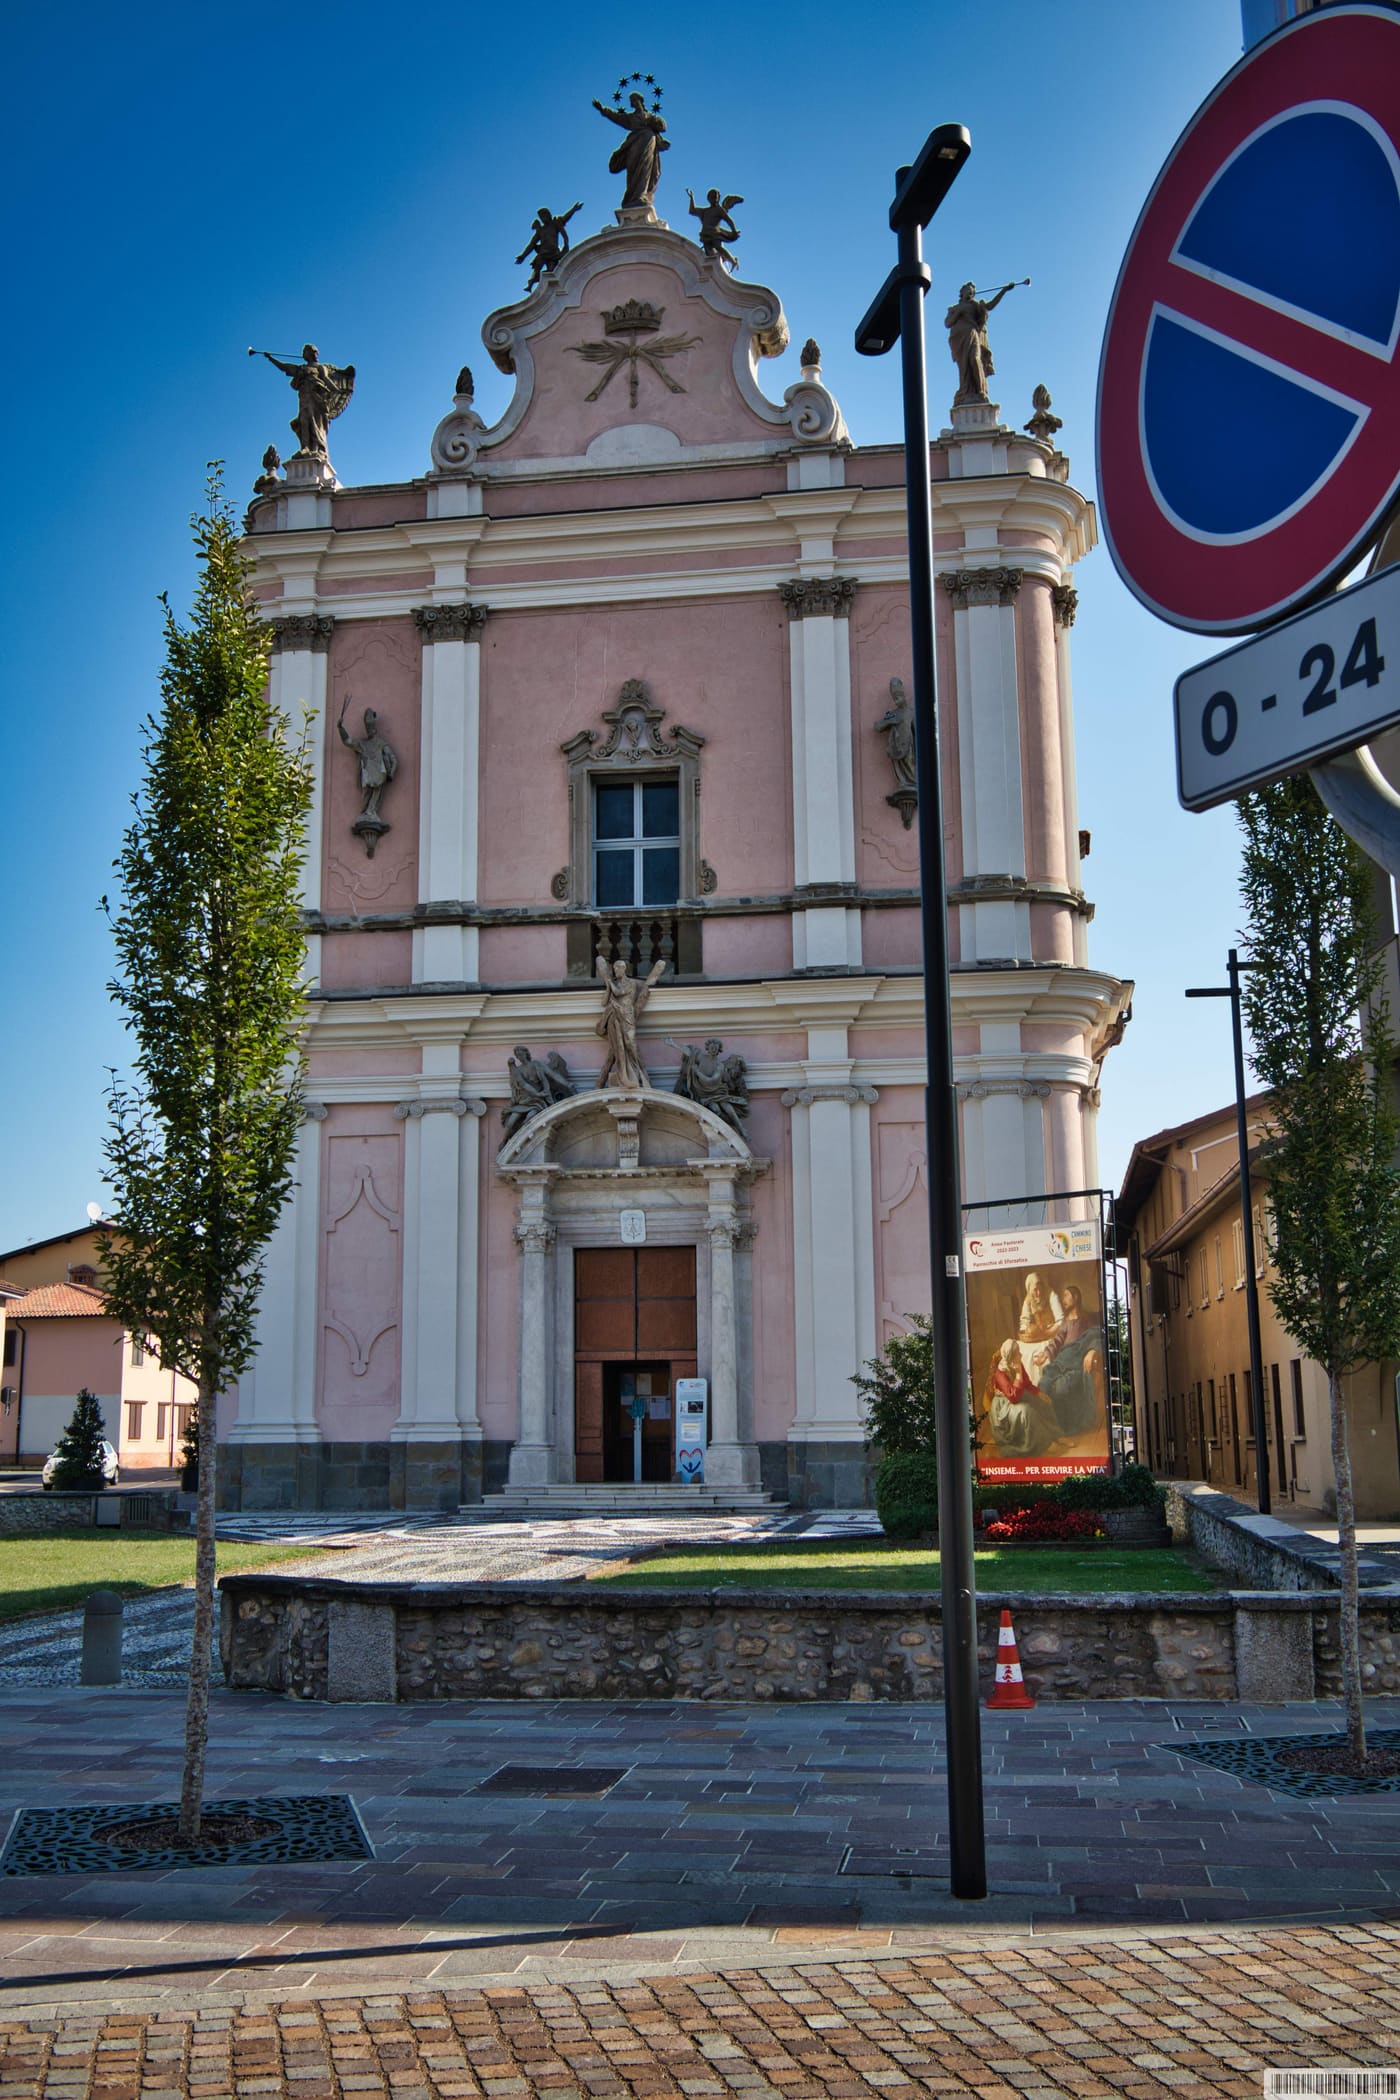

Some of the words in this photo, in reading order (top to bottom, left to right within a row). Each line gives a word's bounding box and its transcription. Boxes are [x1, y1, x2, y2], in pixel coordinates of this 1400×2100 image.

[1201, 690, 1238, 756] 0
[1261, 694, 1277, 713] -
[1299, 616, 1385, 717] 24
[1025, 1466, 1040, 1475] PER
[1041, 1465, 1073, 1475] SERVIRE
[1074, 1465, 1085, 1474] LA
